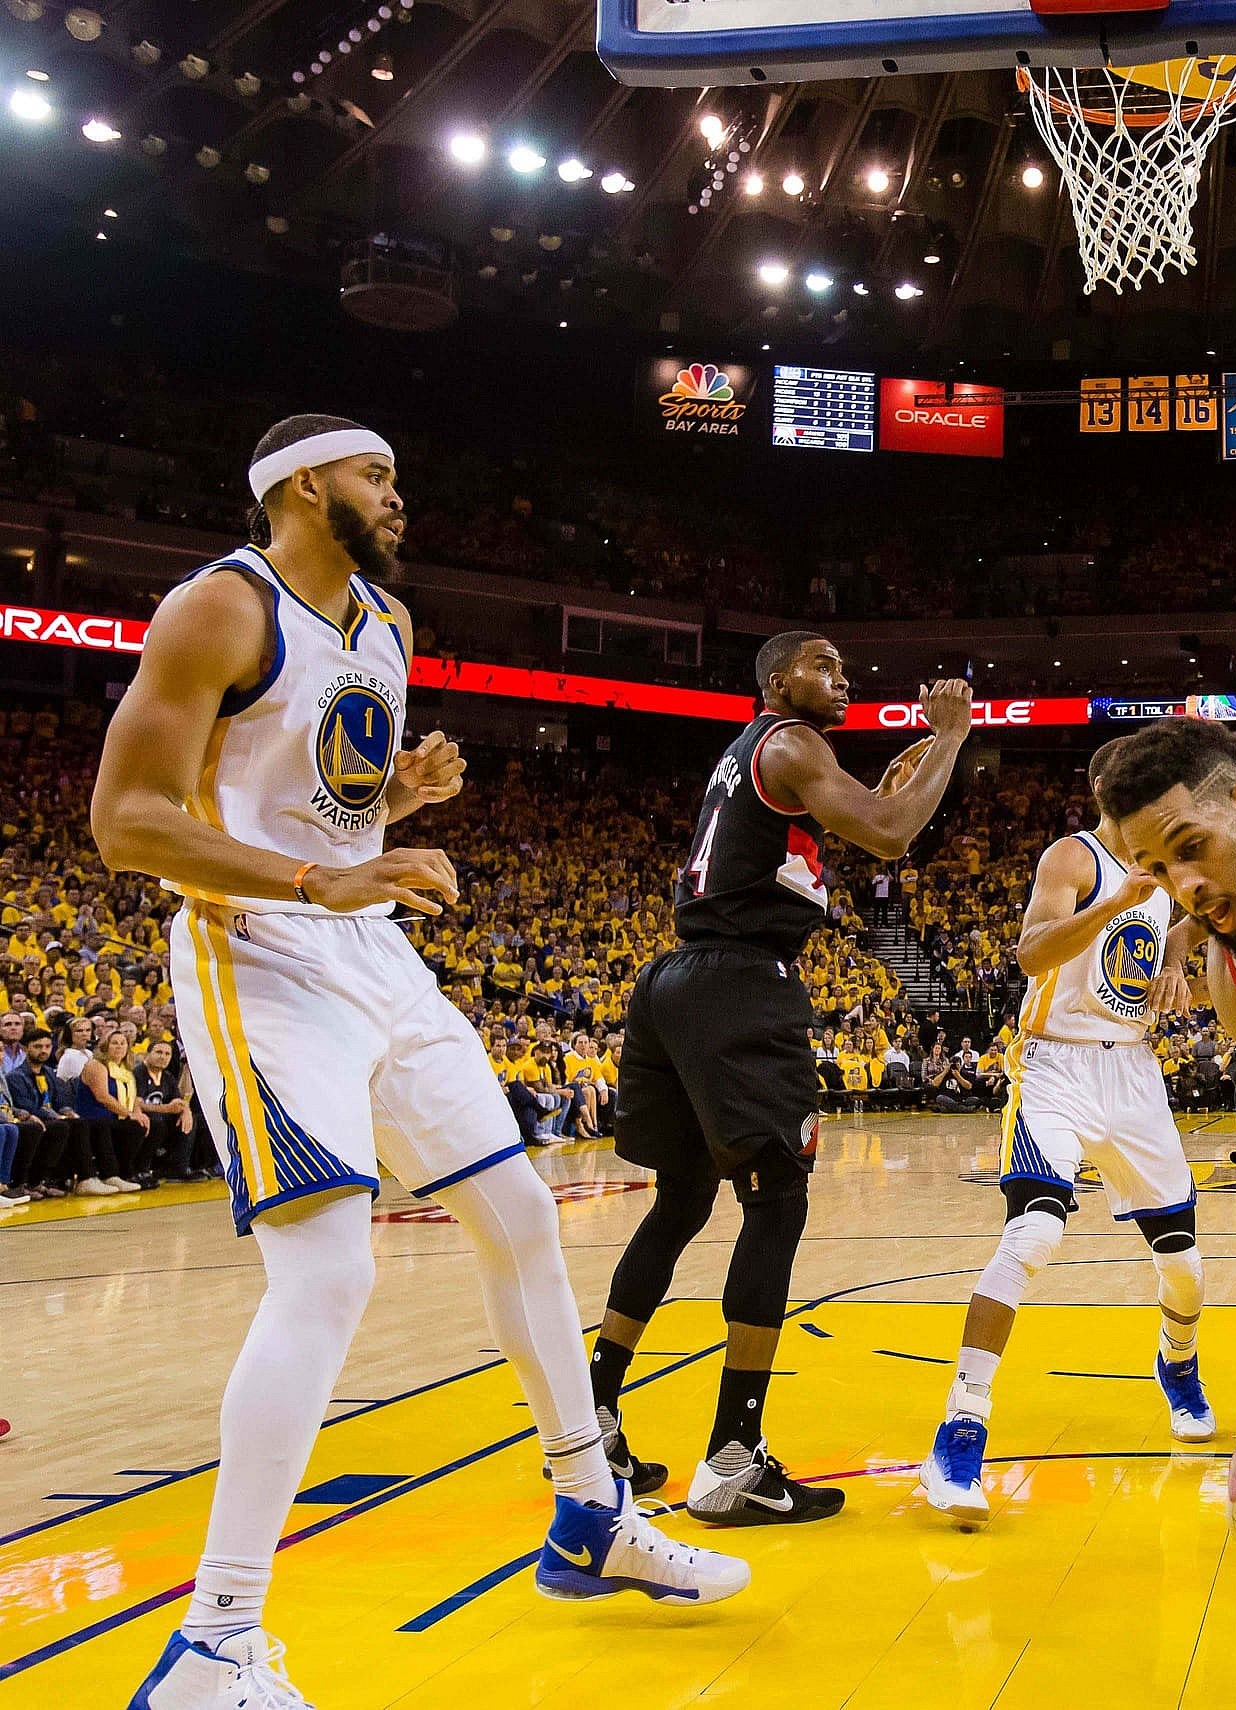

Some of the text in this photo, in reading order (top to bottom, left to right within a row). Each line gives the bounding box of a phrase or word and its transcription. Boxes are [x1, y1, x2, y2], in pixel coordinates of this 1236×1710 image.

[658, 393, 746, 421] Sports
[894, 408, 986, 428] ORACLE
[1088, 398, 1113, 425] 13
[1136, 398, 1161, 424] 14
[1184, 397, 1210, 423] 16
[665, 420, 738, 435] BAY AREA
[0, 607, 149, 651] RACL
[318, 673, 401, 717] GOLDEN STATE
[364, 707, 374, 738] 1
[878, 701, 1031, 727] ORCLE
[1115, 706, 1128, 715] TF
[1129, 705, 1136, 715] 1
[1144, 706, 1163, 715] TOL
[1165, 705, 1174, 714] 4
[310, 786, 386, 830] WARRIOR
[1105, 911, 1145, 932] GOLDEN
[1133, 938, 1154, 961] 30
[1096, 982, 1148, 1018] WARRIO
